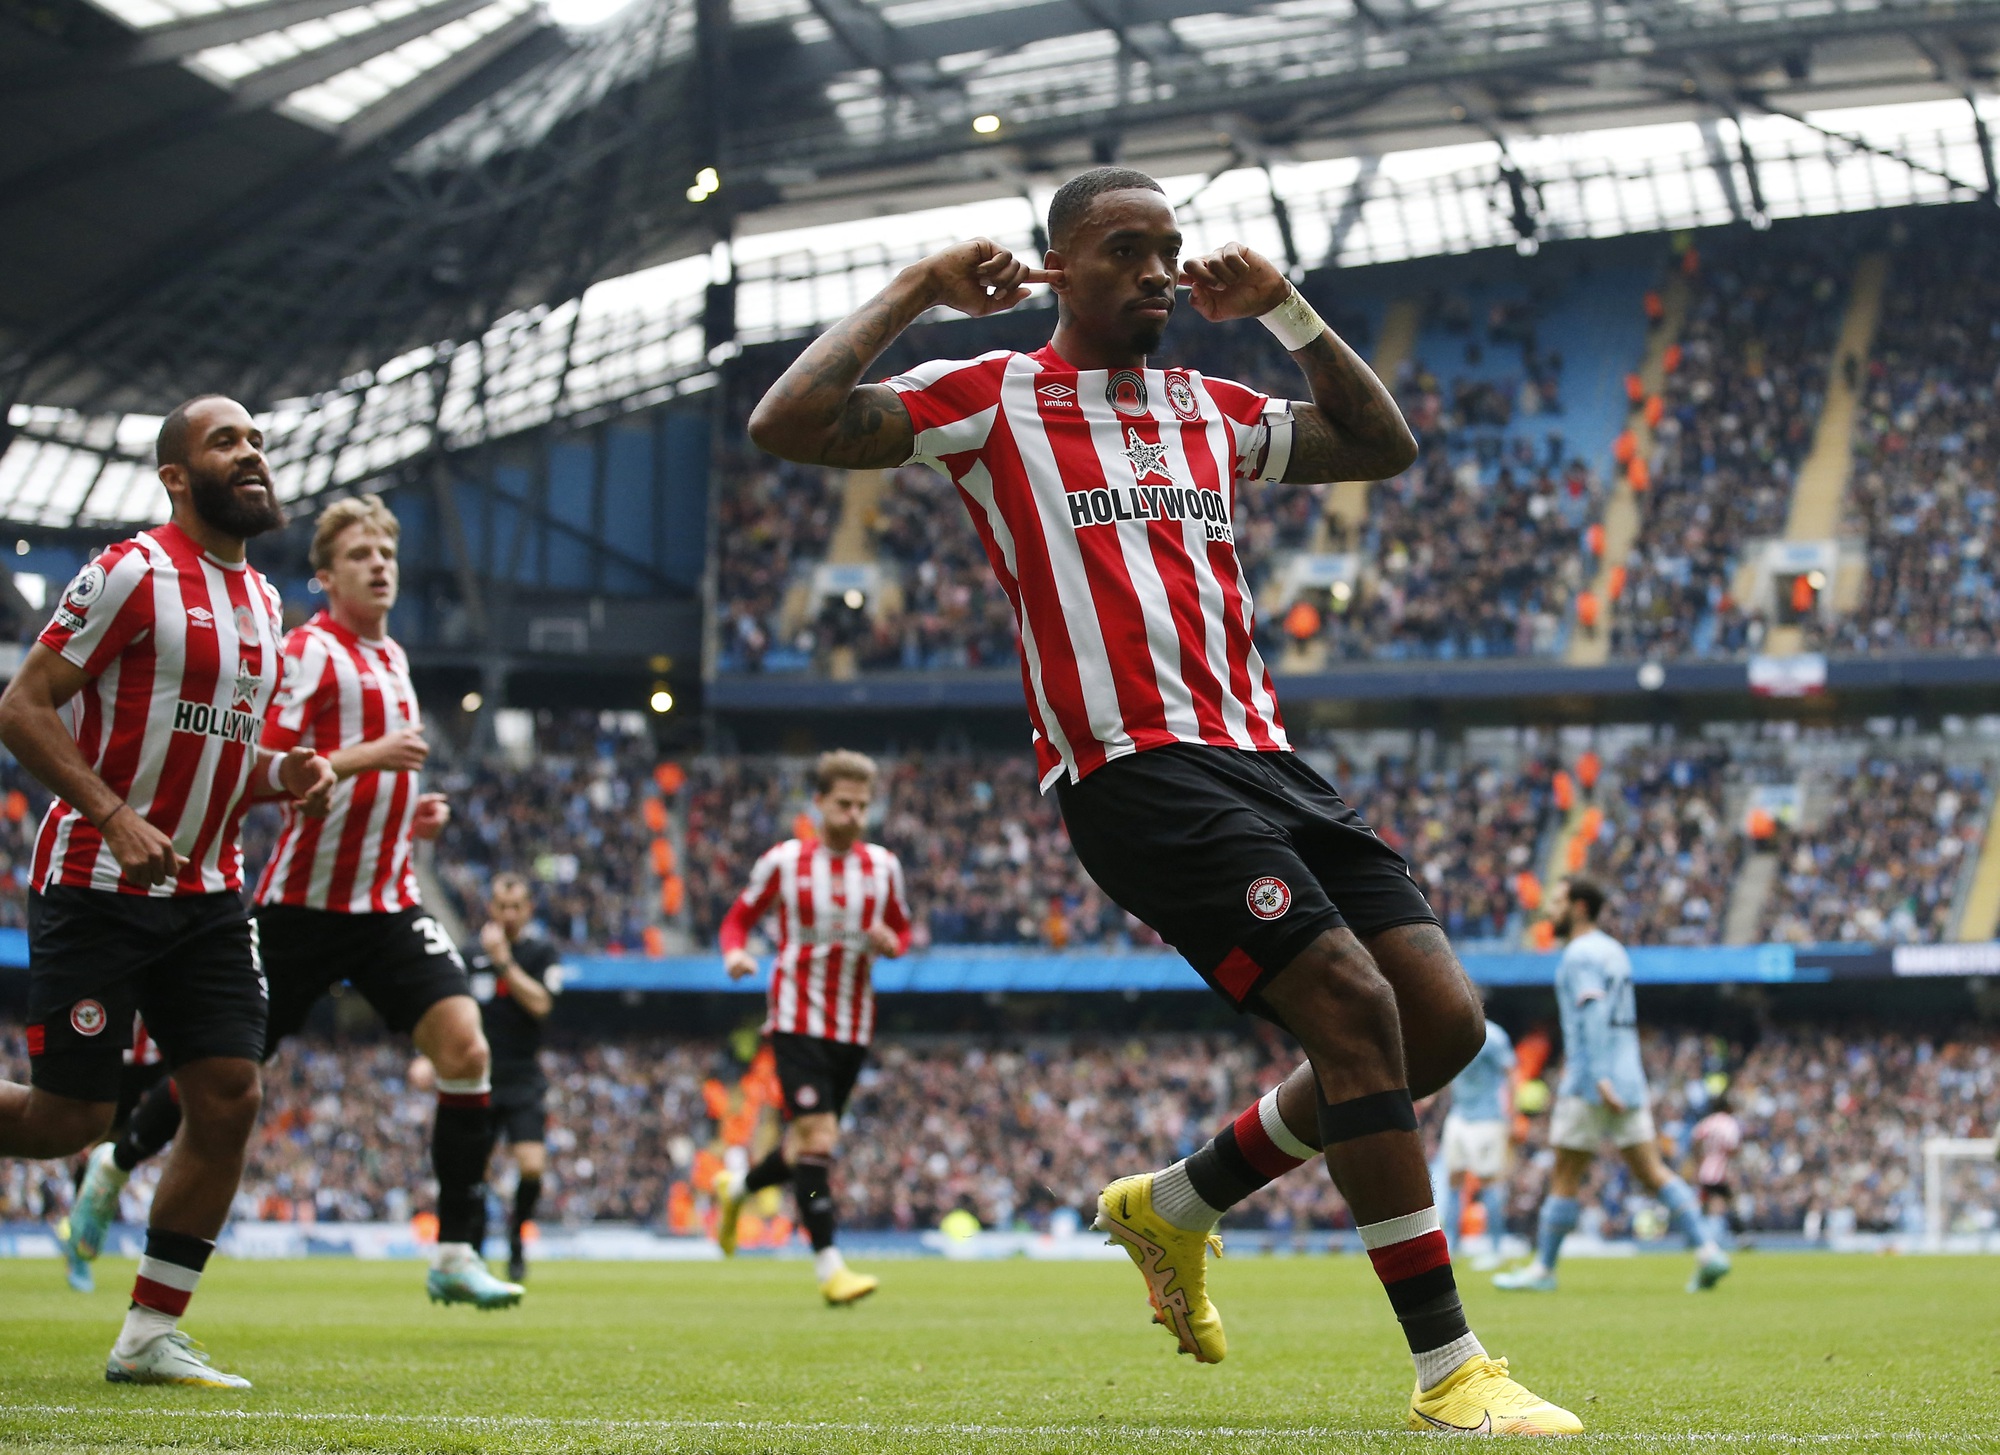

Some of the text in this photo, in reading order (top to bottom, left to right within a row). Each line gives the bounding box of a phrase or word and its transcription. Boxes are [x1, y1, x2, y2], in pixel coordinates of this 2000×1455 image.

[1043, 398, 1073, 407] umbro
[1067, 487, 1228, 526] HOLLYWOOD
[1204, 519, 1233, 543] bets
[1250, 879, 1275, 900] BRENTFORD
